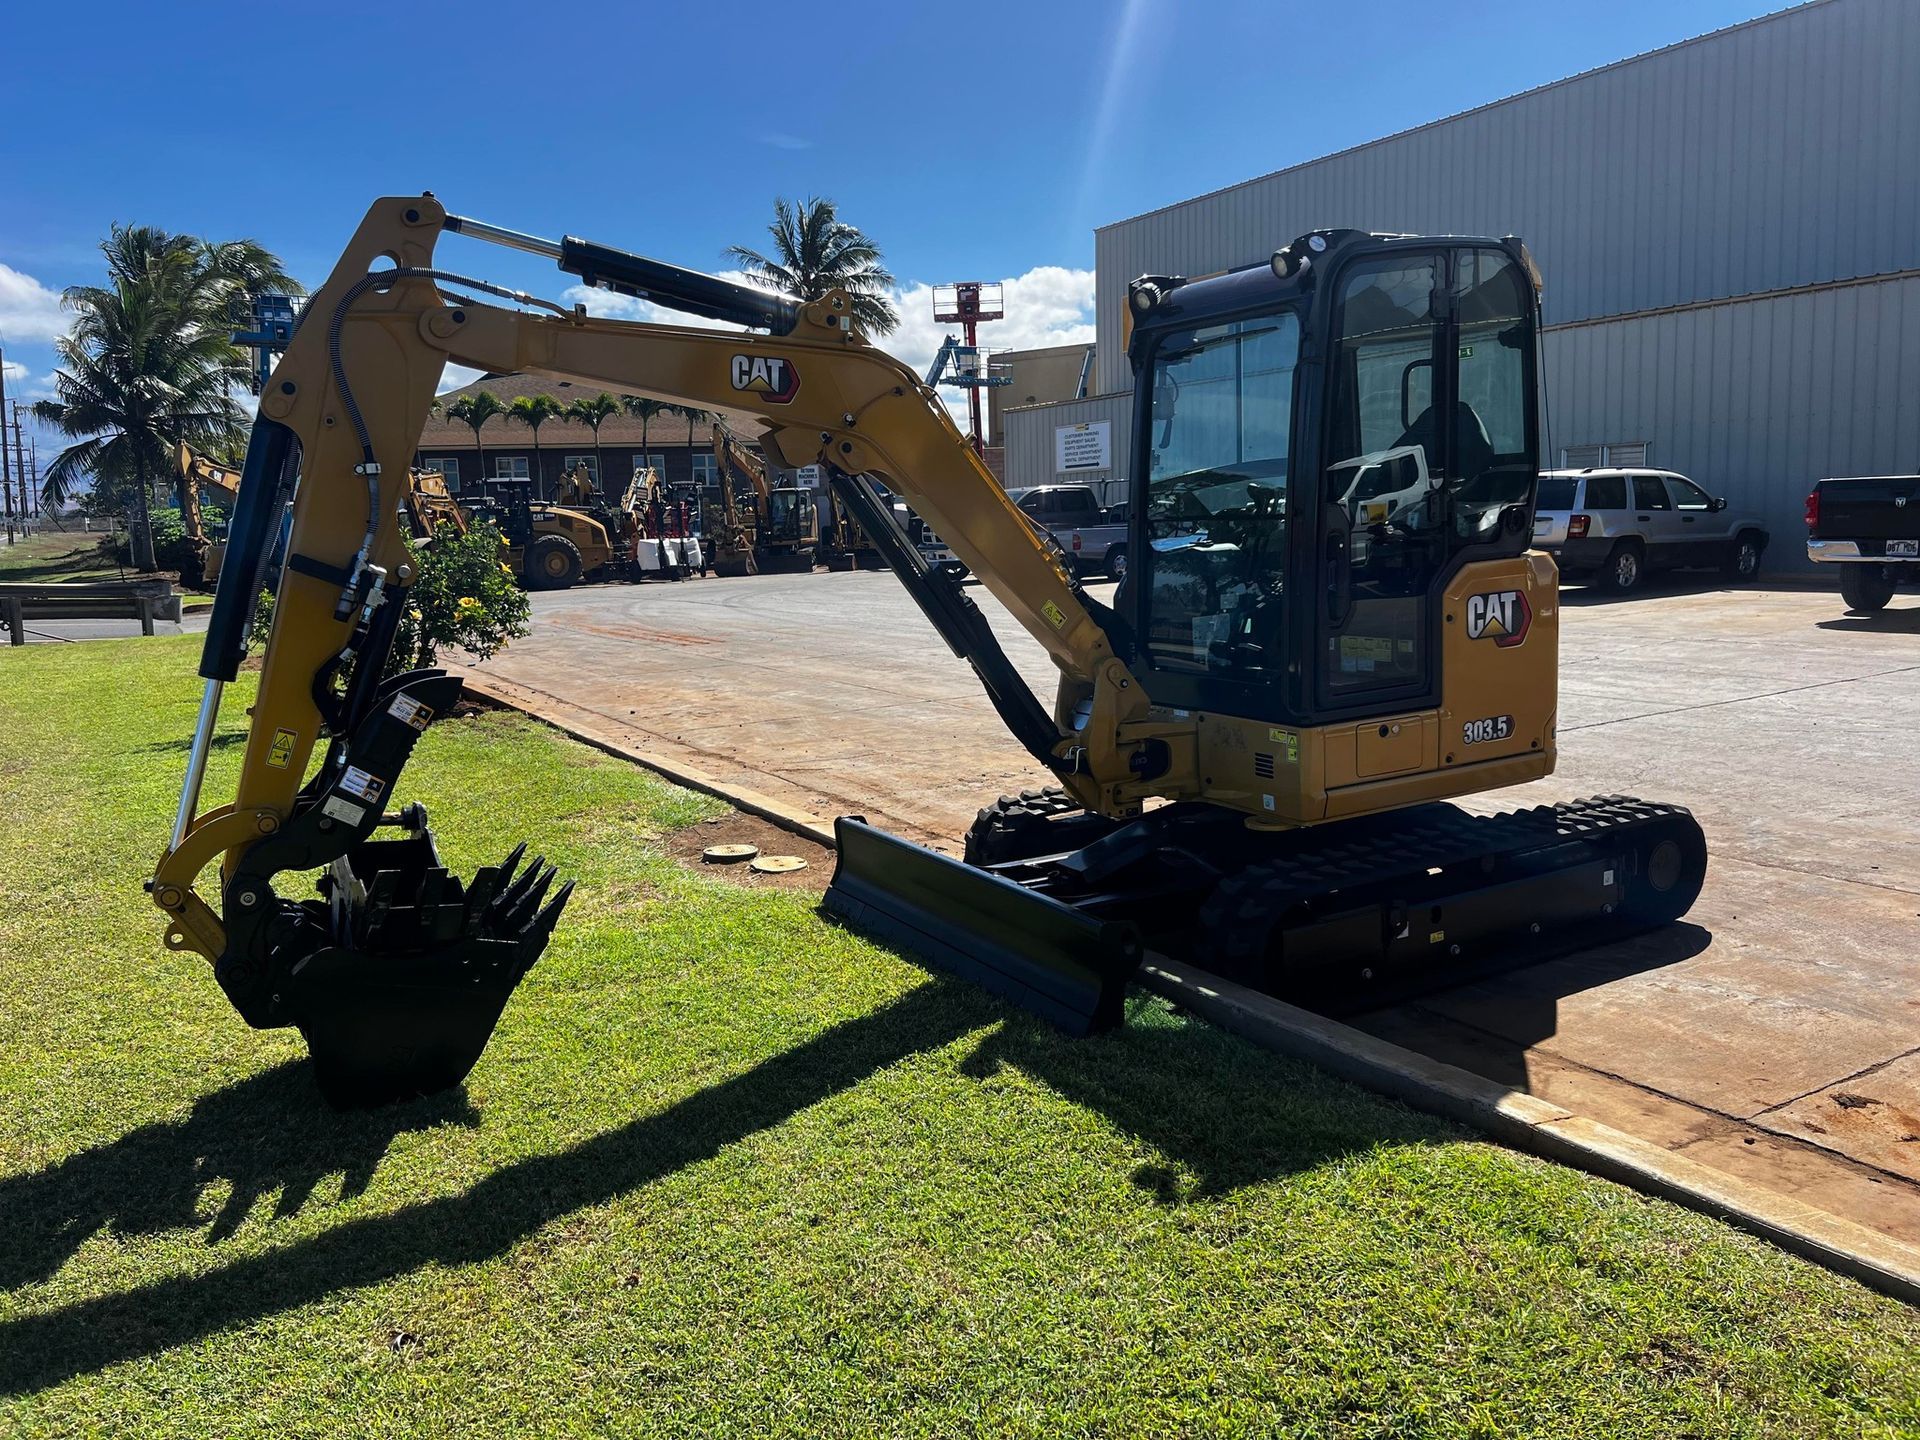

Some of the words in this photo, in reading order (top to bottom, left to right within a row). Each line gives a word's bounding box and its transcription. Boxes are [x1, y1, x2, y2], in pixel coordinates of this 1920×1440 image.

[732, 355, 783, 392] CAT
[1467, 592, 1516, 638] CAT
[1464, 716, 1508, 744] 303.5
